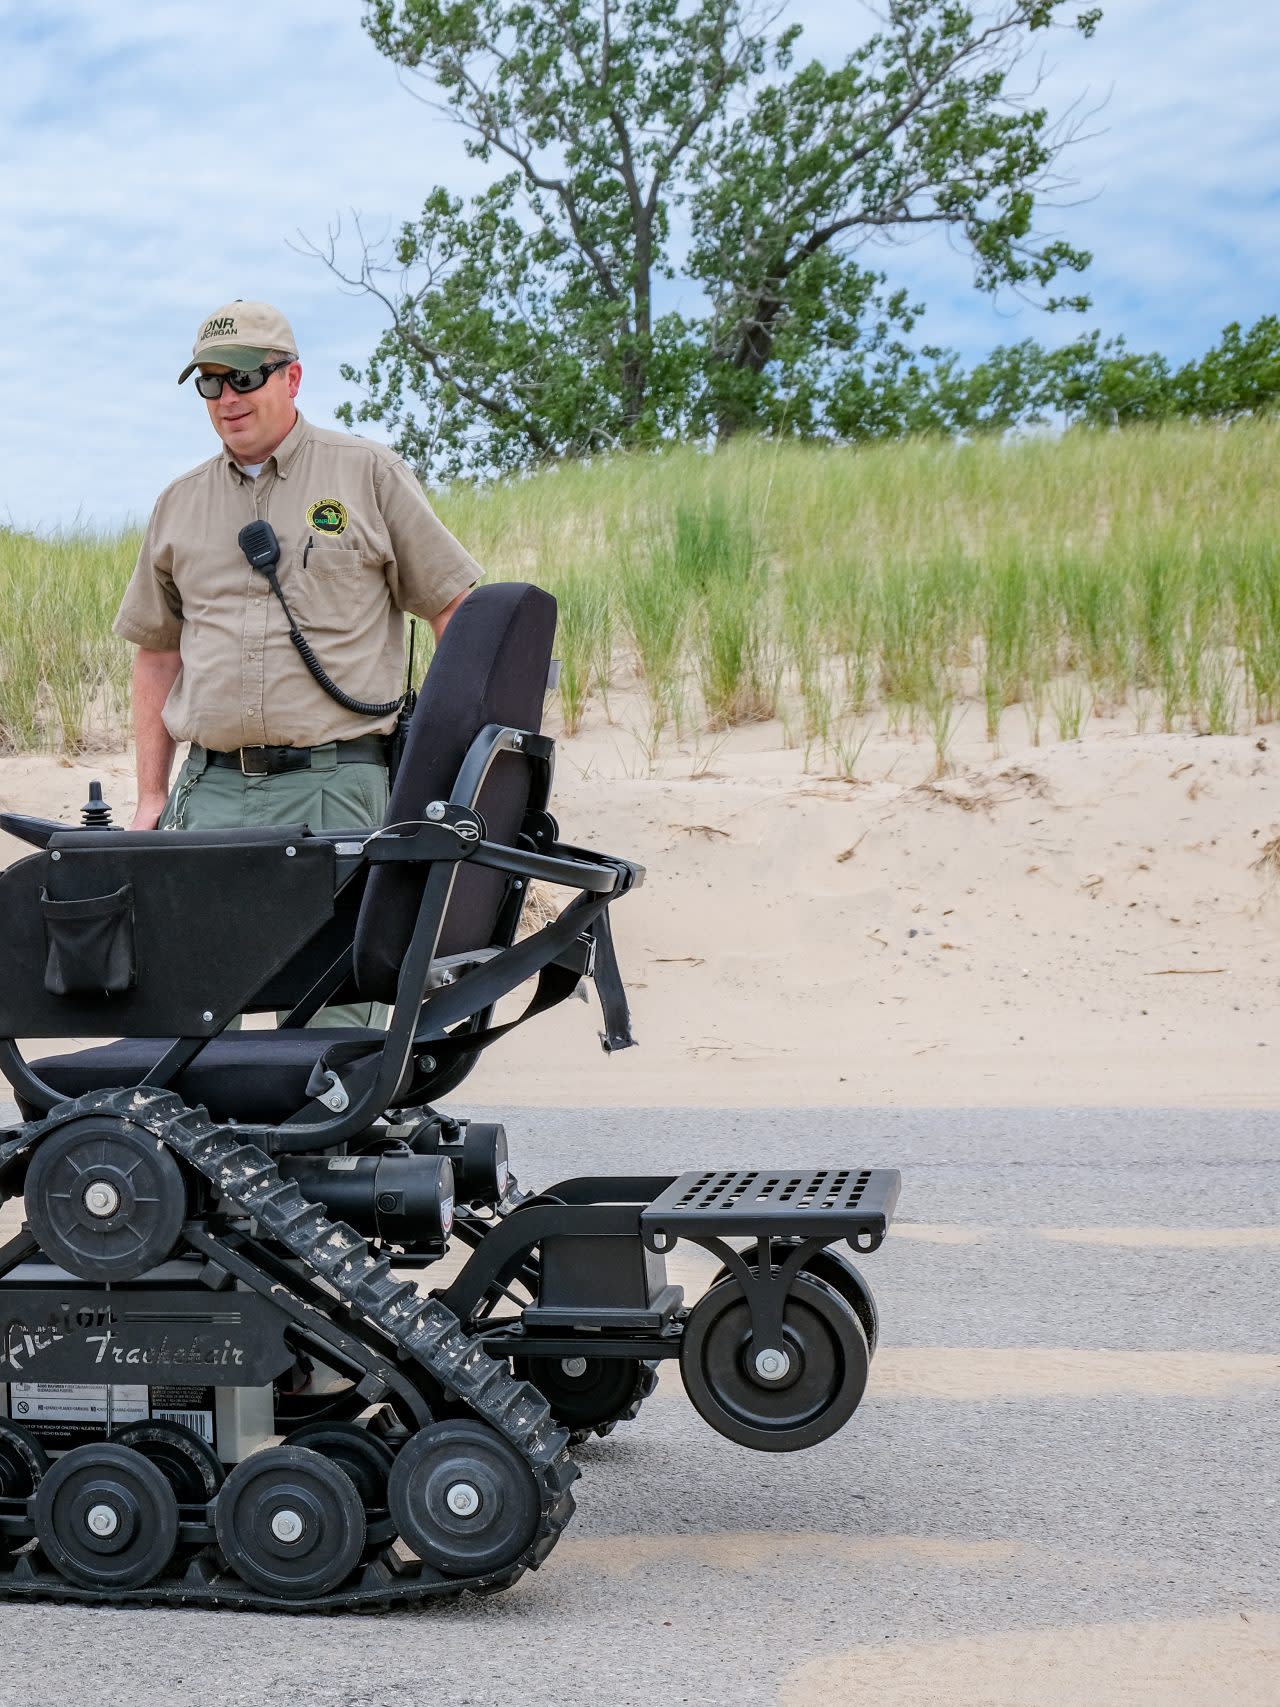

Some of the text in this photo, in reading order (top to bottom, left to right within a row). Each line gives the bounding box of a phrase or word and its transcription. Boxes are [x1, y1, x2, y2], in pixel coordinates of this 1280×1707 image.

[204, 317, 235, 333] DNR
[200, 328, 238, 341] MICHIGAN
[85, 1330, 244, 1366] Trackchair
